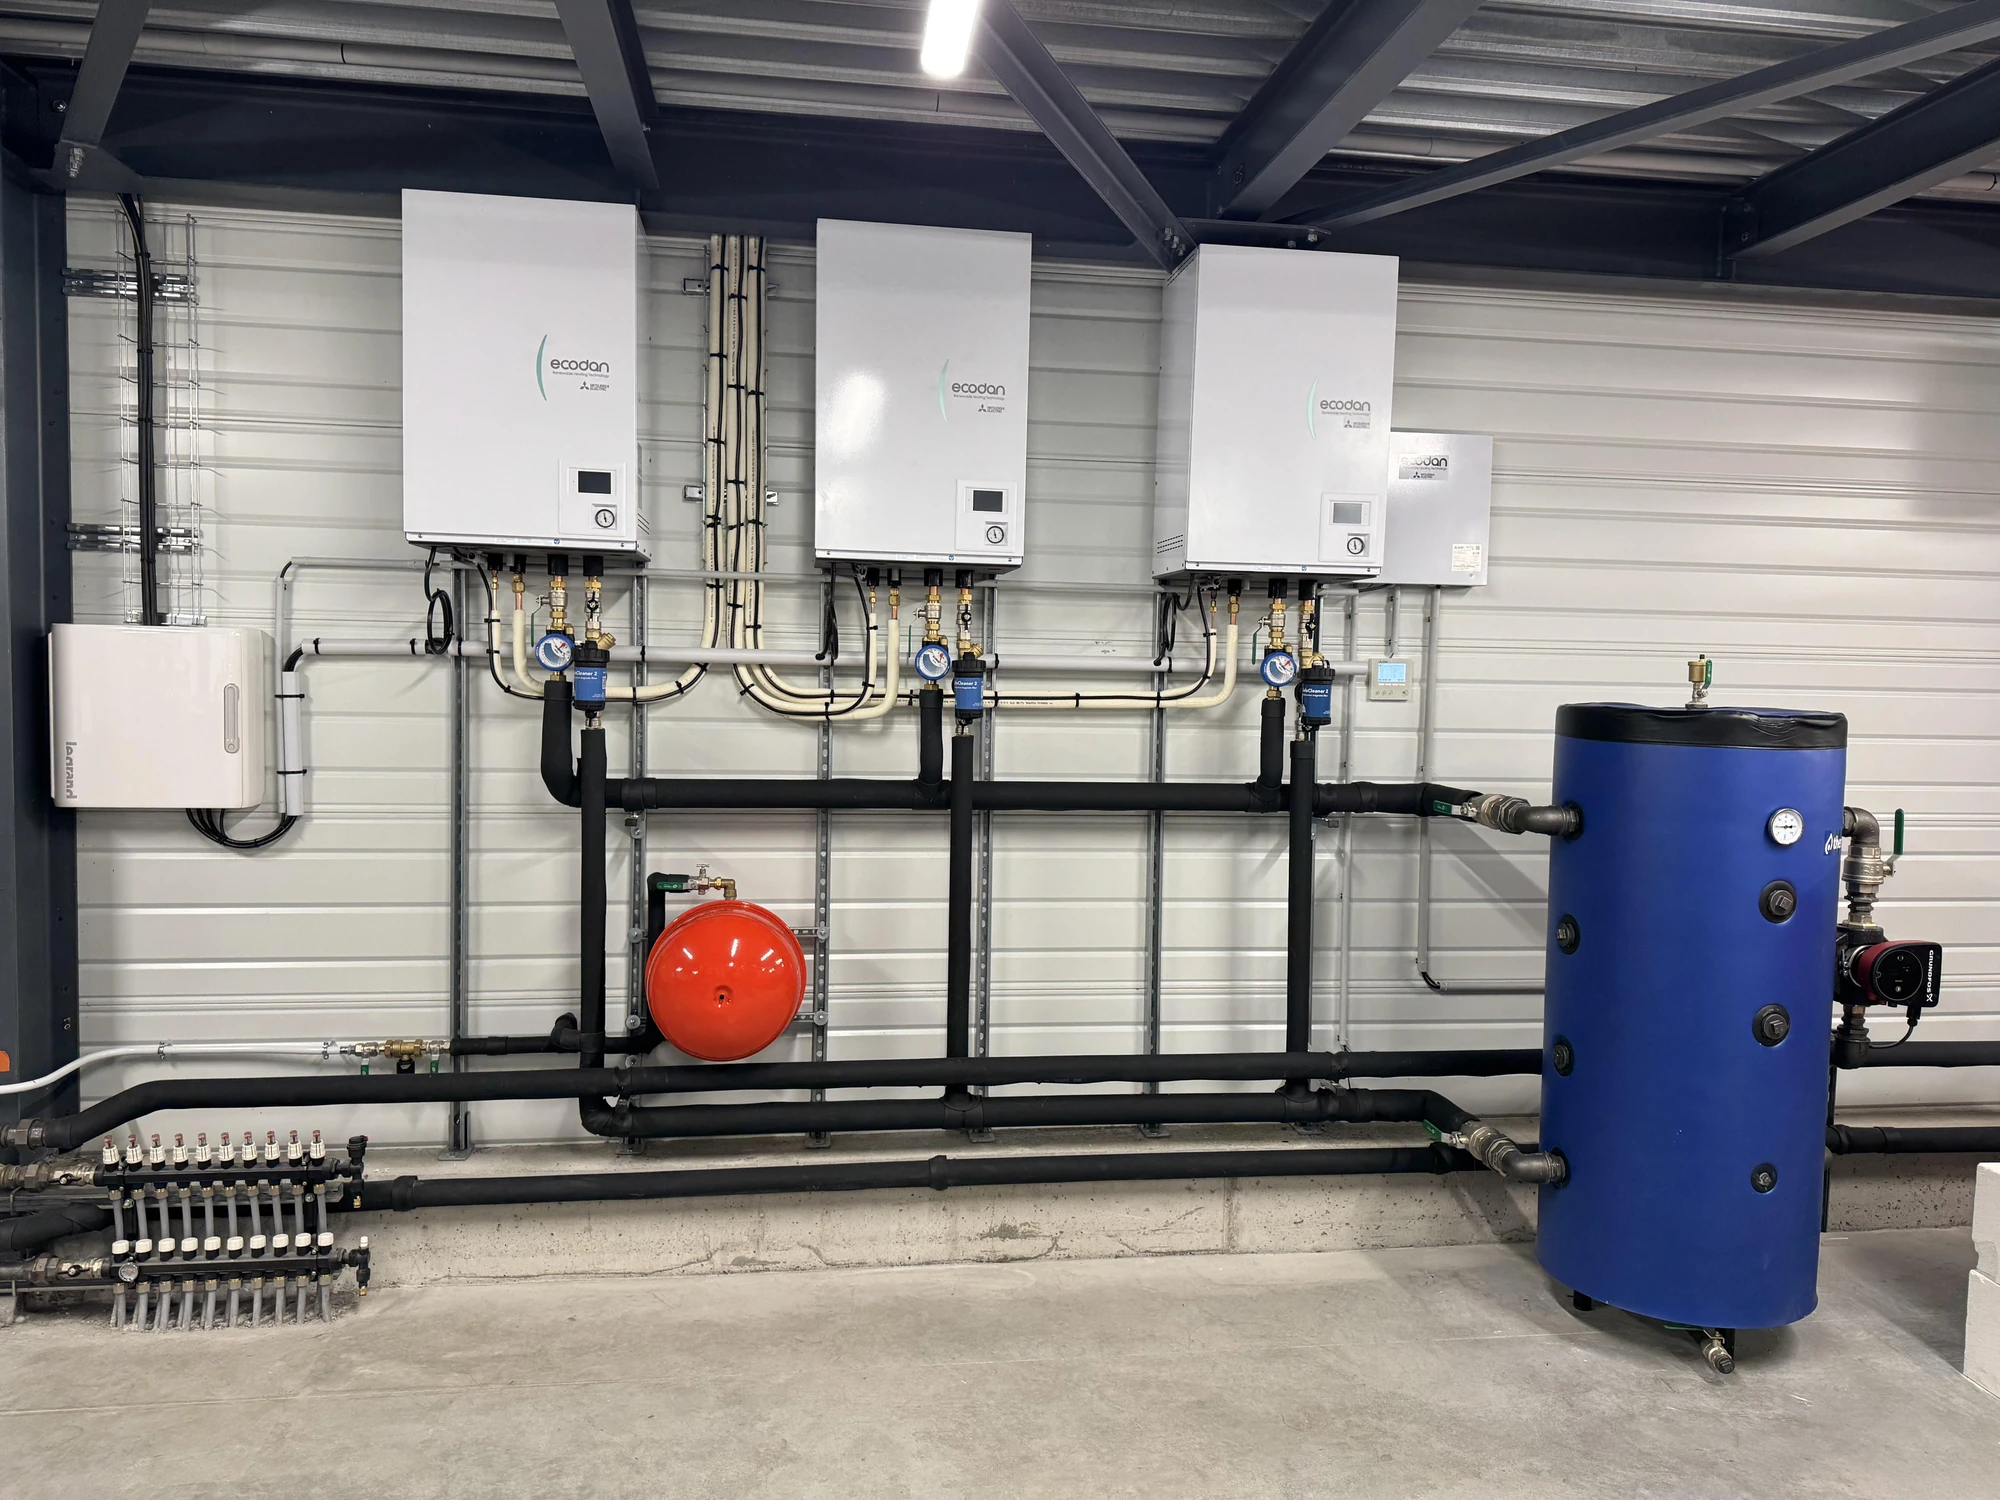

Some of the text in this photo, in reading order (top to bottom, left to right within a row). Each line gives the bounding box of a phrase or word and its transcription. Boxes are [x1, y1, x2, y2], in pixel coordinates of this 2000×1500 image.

[550, 359, 609, 373] ecodan
[952, 383, 1005, 395] ecodan
[1320, 400, 1370, 411] ecodan
[1401, 456, 1448, 467] odan
[66, 741, 77, 799] legrand
[1926, 950, 1934, 993] GRUNDFOS
